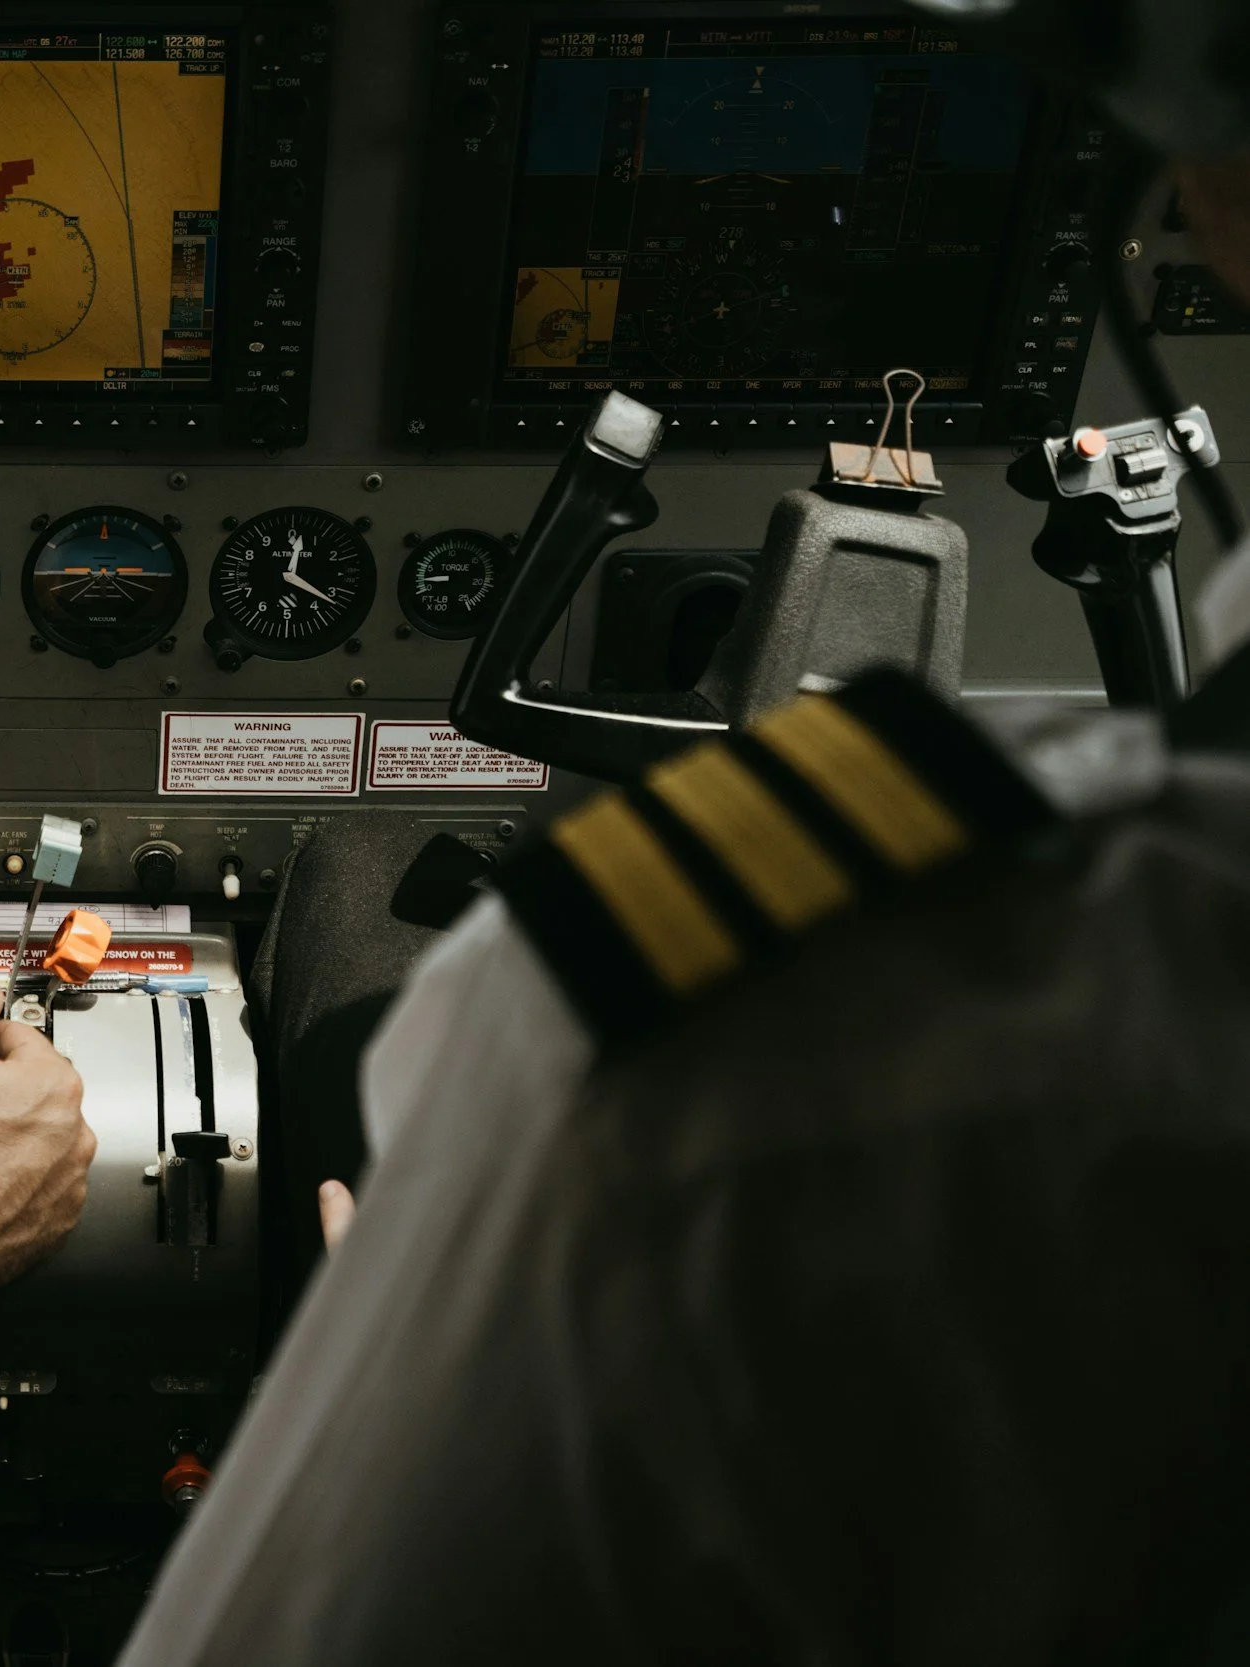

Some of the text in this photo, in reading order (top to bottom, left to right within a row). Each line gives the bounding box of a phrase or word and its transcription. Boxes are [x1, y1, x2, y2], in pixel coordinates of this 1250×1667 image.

[165, 37, 205, 47] 122.200
[562, 34, 645, 45] 112.20 113.40
[106, 49, 205, 59] 121.500 126.700
[560, 46, 643, 57] 112.20 113.40
[277, 78, 301, 87] COM
[468, 76, 489, 86] NAV
[270, 159, 298, 168] BARO
[263, 237, 297, 246] RANGE
[266, 300, 285, 308] PAN
[1048, 295, 1069, 304] PAN
[261, 384, 279, 392] FMS
[549, 380, 842, 390] INSET SENSOR PFD OBS CDI IDENT
[1028, 381, 1047, 390] FMS
[262, 536, 271, 547] 9
[245, 550, 254, 560] 8
[329, 550, 338, 561] 2
[441, 564, 469, 572] TORQUE
[472, 578, 484, 586] 20
[328, 587, 336, 597] 3
[458, 594, 469, 602] 25
[258, 601, 267, 612] 6
[309, 601, 319, 610] 4
[283, 609, 292, 620] 5
[234, 723, 291, 731] WARNING
[140, 951, 176, 960] ON THE
[33, 1384, 40, 1393] R
